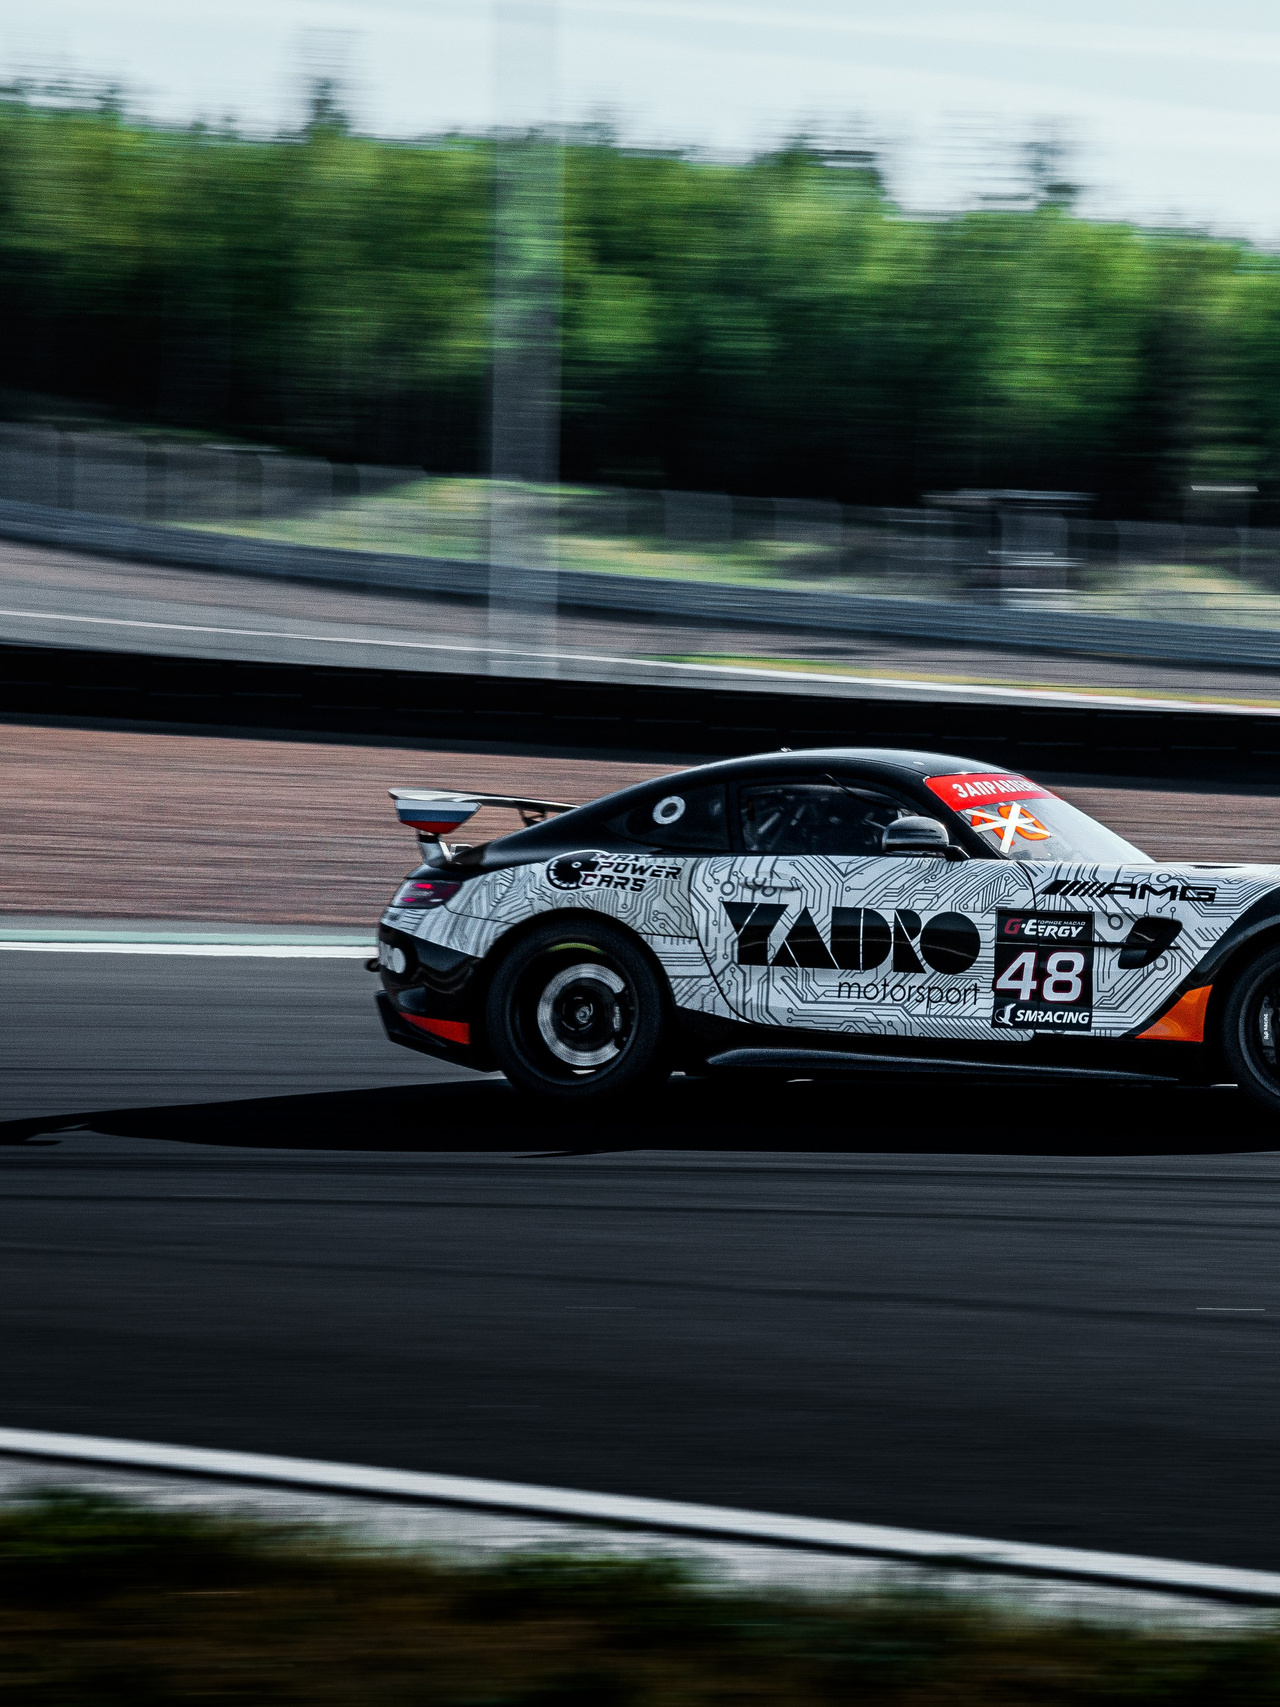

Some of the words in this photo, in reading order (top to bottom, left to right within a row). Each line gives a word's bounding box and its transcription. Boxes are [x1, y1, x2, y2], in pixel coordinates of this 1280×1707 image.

[581, 873, 646, 892] CARS
[598, 861, 682, 880] POWER
[1096, 882, 1217, 902] AMG
[721, 900, 982, 976] YADRO
[996, 951, 1085, 1002] 48
[837, 978, 981, 1009] motorsport
